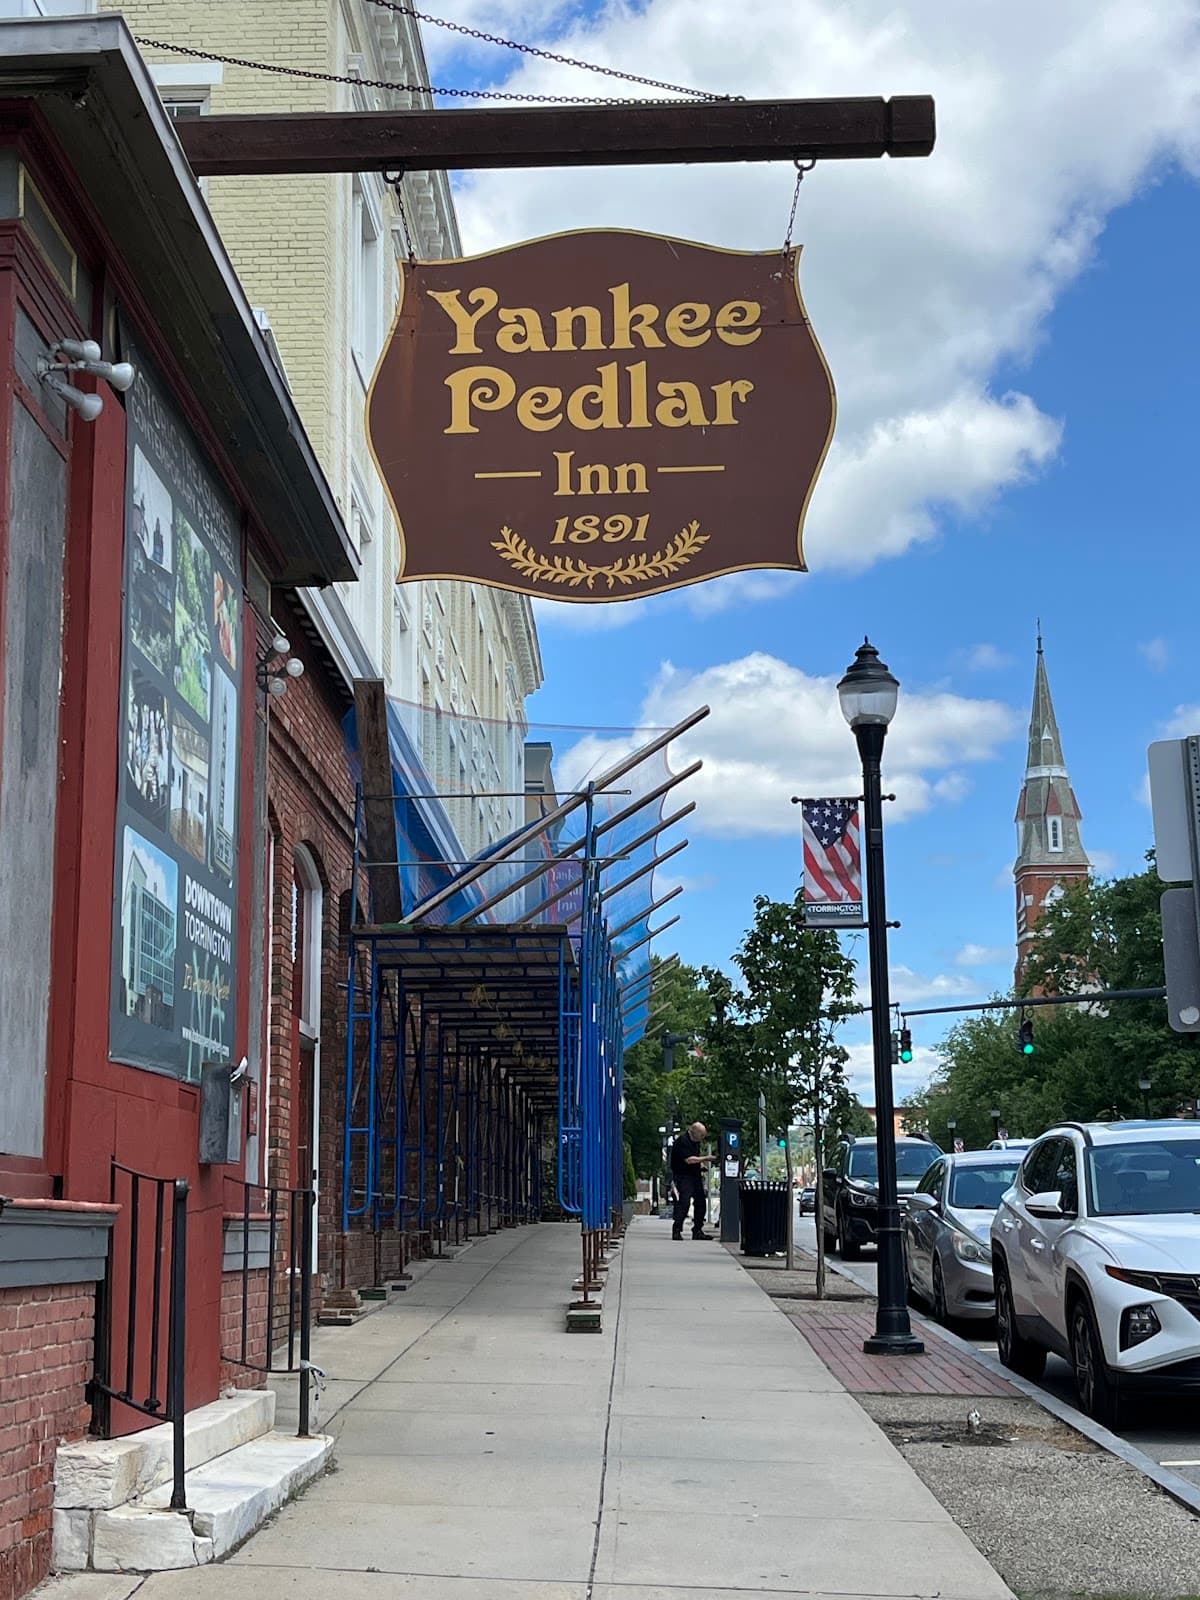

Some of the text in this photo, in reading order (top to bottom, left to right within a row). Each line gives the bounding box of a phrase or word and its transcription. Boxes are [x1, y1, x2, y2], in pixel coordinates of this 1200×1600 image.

[426, 282, 762, 355] Yankee
[443, 360, 755, 434] Pedlar
[553, 451, 650, 496] Inn
[550, 513, 650, 544] 1891
[185, 874, 232, 934] DOWNTOWN
[184, 910, 231, 965] TORRINGTON
[729, 1133, 738, 1145] P
